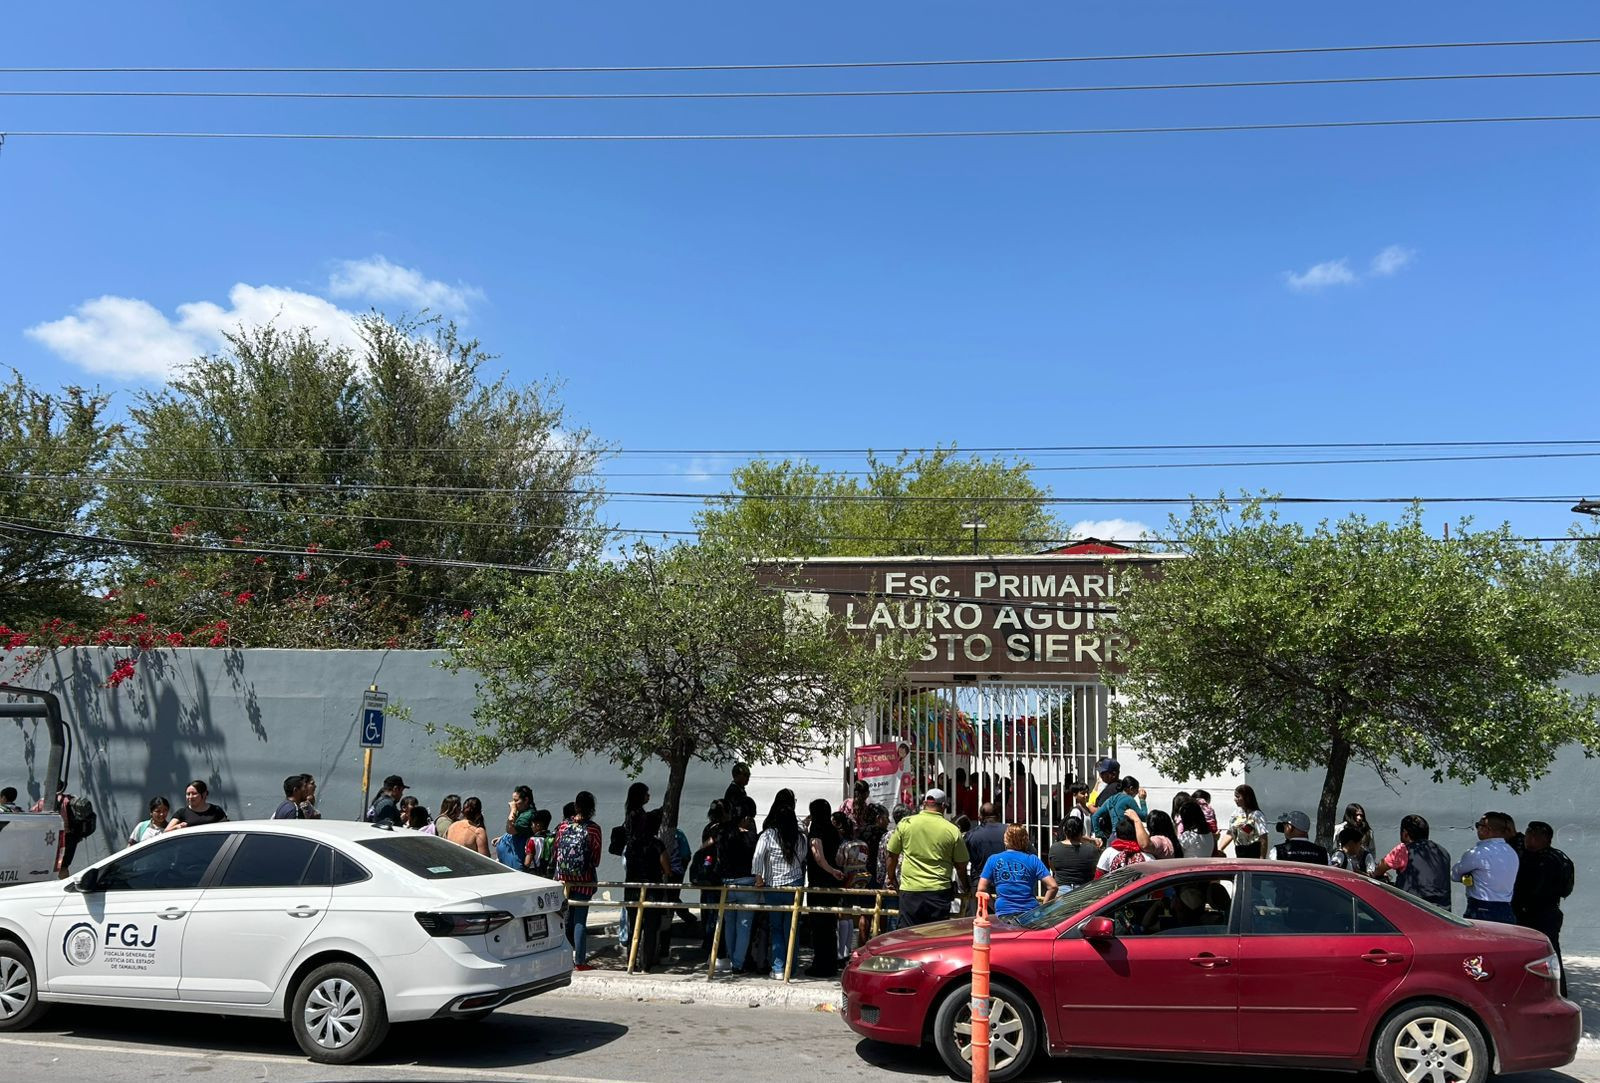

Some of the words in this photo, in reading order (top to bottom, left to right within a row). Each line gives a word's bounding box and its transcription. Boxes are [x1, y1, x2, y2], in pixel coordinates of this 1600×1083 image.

[846, 602, 983, 630] LAURO
[992, 602, 1122, 630] AGUIR
[1006, 633, 1130, 662] SIERR
[105, 923, 158, 948] FGJ
